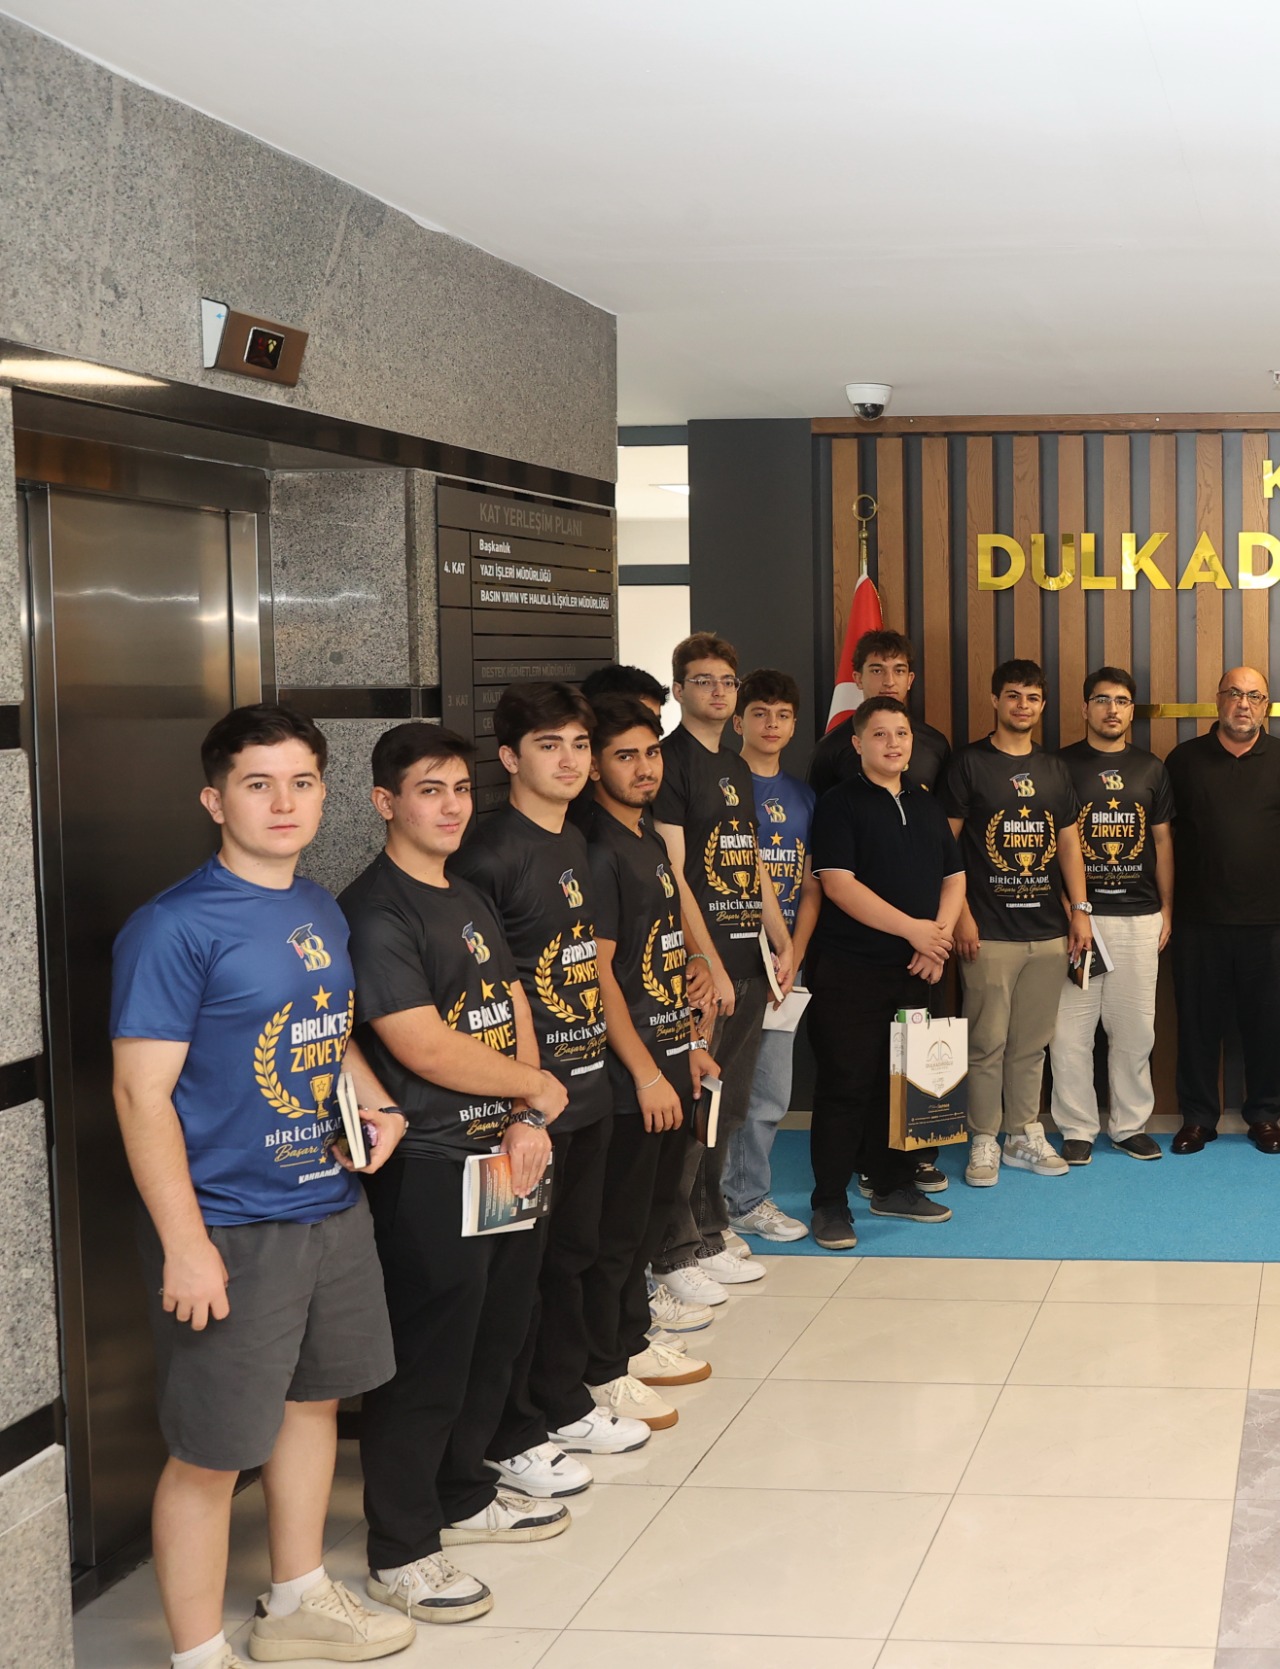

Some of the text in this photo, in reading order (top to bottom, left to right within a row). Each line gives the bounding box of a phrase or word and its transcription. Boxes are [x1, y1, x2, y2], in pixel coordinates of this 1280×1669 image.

[480, 503, 583, 537] KAT YERLEŞİM PLANI
[479, 539, 511, 554] Başkanlık
[443, 561, 466, 575] 4. KAT
[480, 563, 551, 583] YAZI İŞLERİ MÜDÜRLÜĞÜ
[480, 590, 610, 610] BASIN YAYIN VE HALKLA İLİŞKİLER MÜDÜRLÜĞÜ
[482, 666, 506, 679] DESTEK
[456, 694, 468, 707] KAT
[1092, 811, 1136, 824] BİRLİKTE
[1004, 819, 1045, 833] BİRLİKTE
[1091, 824, 1135, 838] ZİRVEYE
[1003, 832, 1044, 848] ZİRVEYE
[989, 875, 1023, 885] BİRİCİK
[708, 899, 744, 911] BİRİCİK
[291, 1011, 348, 1045] BİRLİKTE
[546, 1026, 592, 1044] BİRİCİK
[459, 1100, 507, 1122] BİRİCİK
[274, 1144, 318, 1162] Başarı
